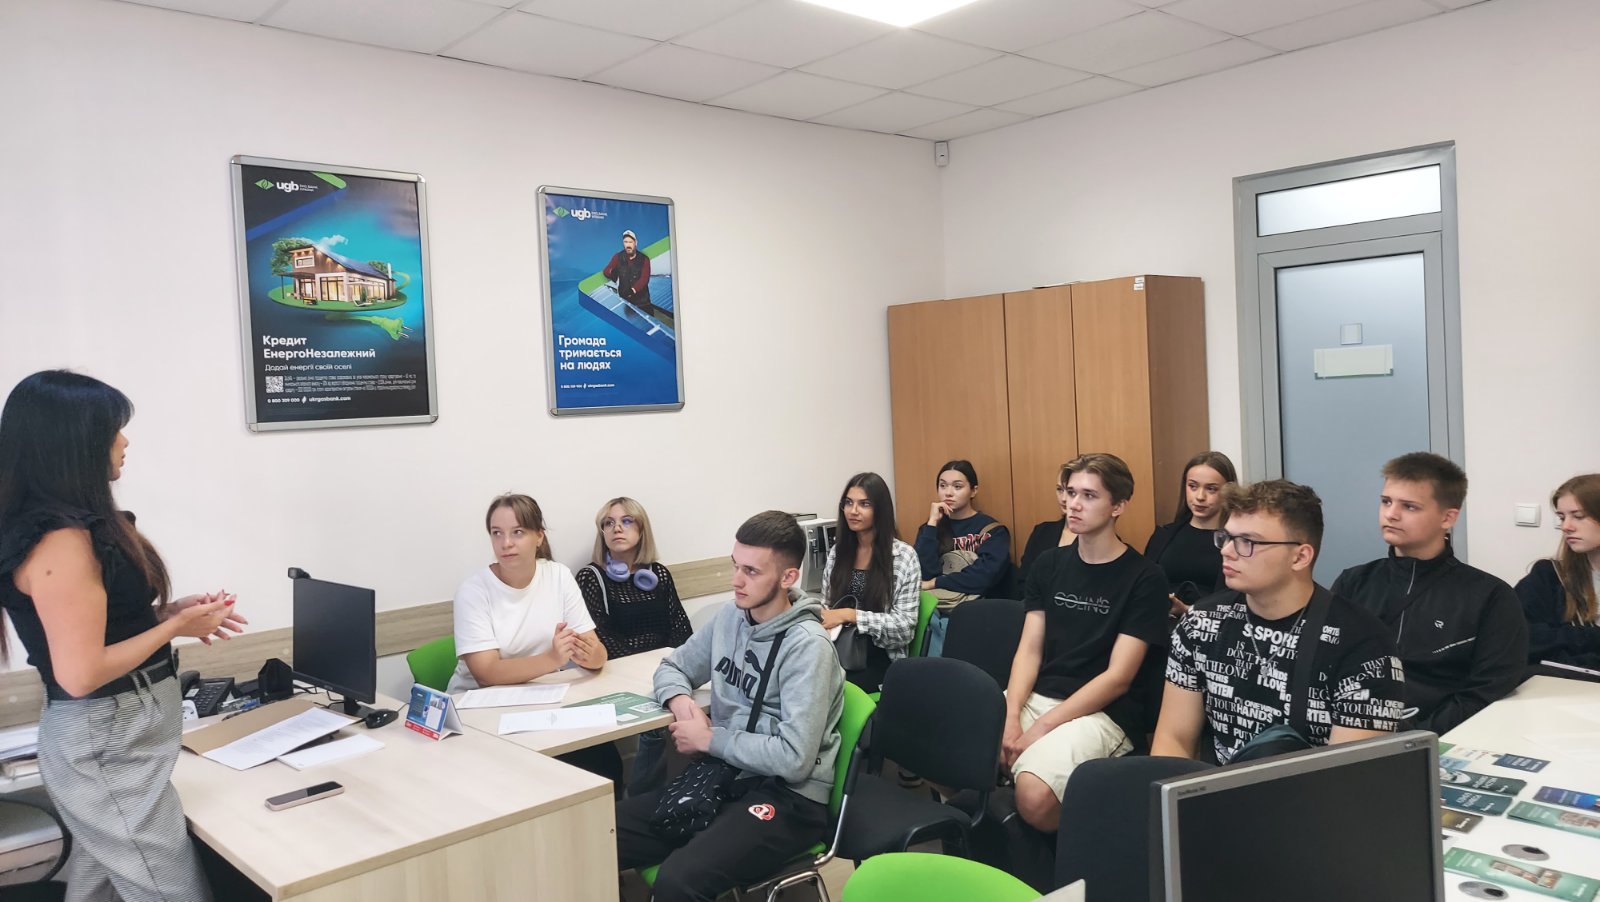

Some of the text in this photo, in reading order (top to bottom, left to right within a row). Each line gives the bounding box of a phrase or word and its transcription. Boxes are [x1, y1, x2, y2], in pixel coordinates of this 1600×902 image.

[276, 180, 299, 193] ugb
[570, 207, 591, 221] ugb
[262, 335, 307, 347] Кредит
[558, 334, 607, 348] Громада
[263, 348, 376, 360] ЕнергоНезалежний
[558, 349, 622, 361] тримається
[264, 364, 289, 372] Додай
[560, 361, 611, 372] на людях
[1254, 625, 1300, 649] SPORE
[1339, 715, 1370, 729] THAT
